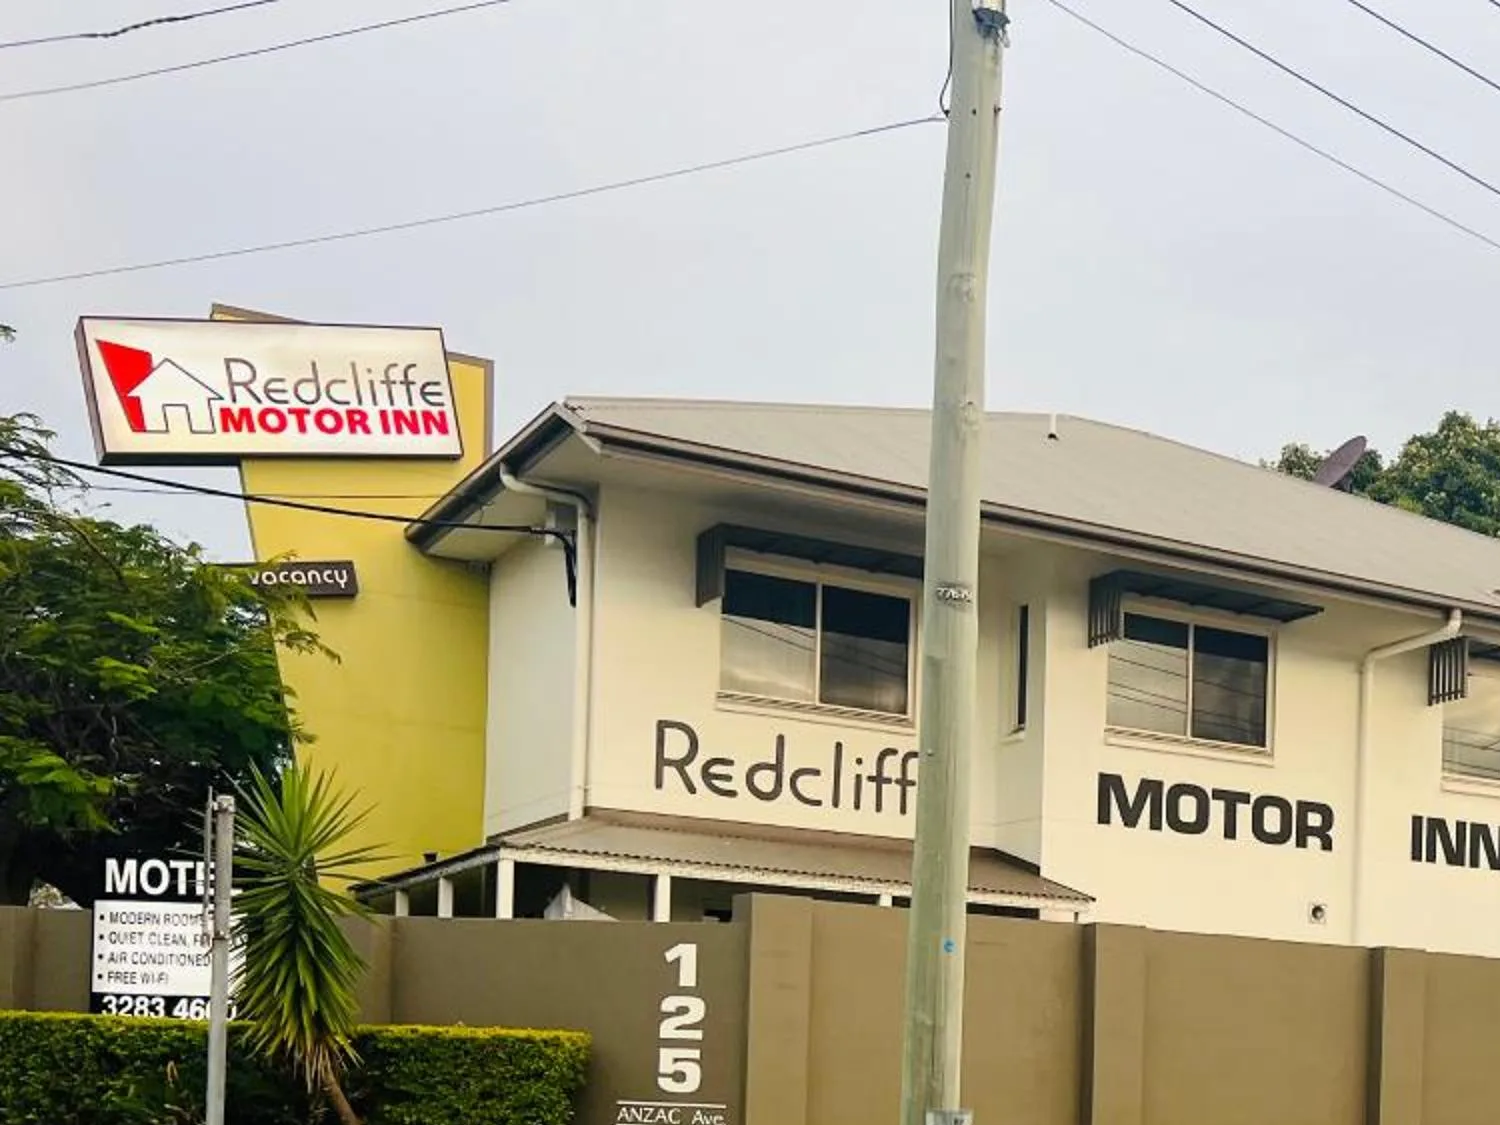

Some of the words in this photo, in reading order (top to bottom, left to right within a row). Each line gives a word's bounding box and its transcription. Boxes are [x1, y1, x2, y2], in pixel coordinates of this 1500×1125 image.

[223, 357, 445, 407] Redcliffe
[219, 407, 372, 435] MOTOR
[379, 409, 450, 436] INN
[248, 569, 348, 589] vacancy
[655, 719, 919, 815] Redcliff
[1097, 772, 1334, 852] MOTOR
[109, 911, 160, 925] MODERN
[108, 931, 144, 945] QUIET
[107, 951, 128, 964] AIR
[131, 951, 211, 967] CONDITIONED
[107, 971, 137, 984] FREE
[101, 996, 165, 1019] 3283
[656, 942, 706, 1094] 125
[617, 1106, 681, 1125] ANZAC
